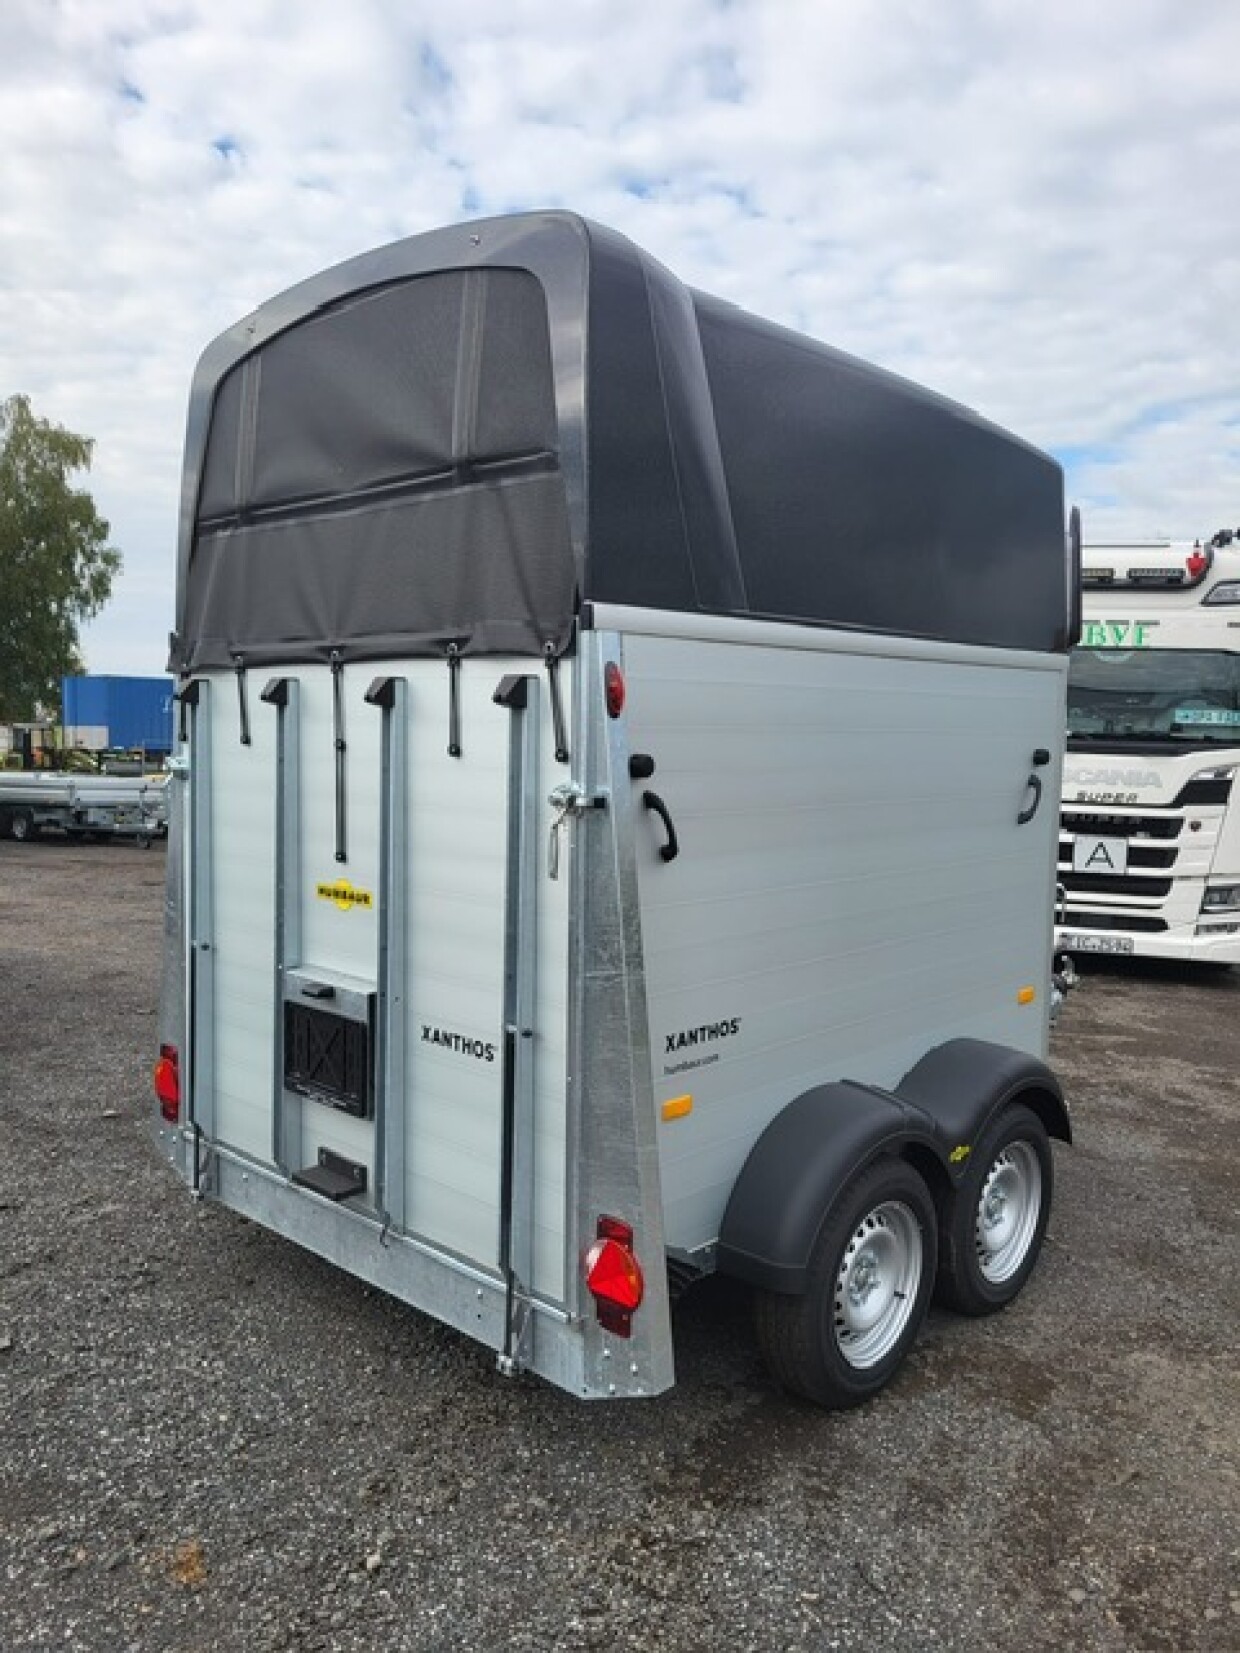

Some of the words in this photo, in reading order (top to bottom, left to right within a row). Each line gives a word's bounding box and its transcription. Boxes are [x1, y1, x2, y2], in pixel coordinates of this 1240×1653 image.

[1076, 791, 1138, 803] SUPER
[1084, 841, 1115, 869] A
[421, 1025, 495, 1062] XANTHOS
[664, 1017, 741, 1054] XANTHOS
